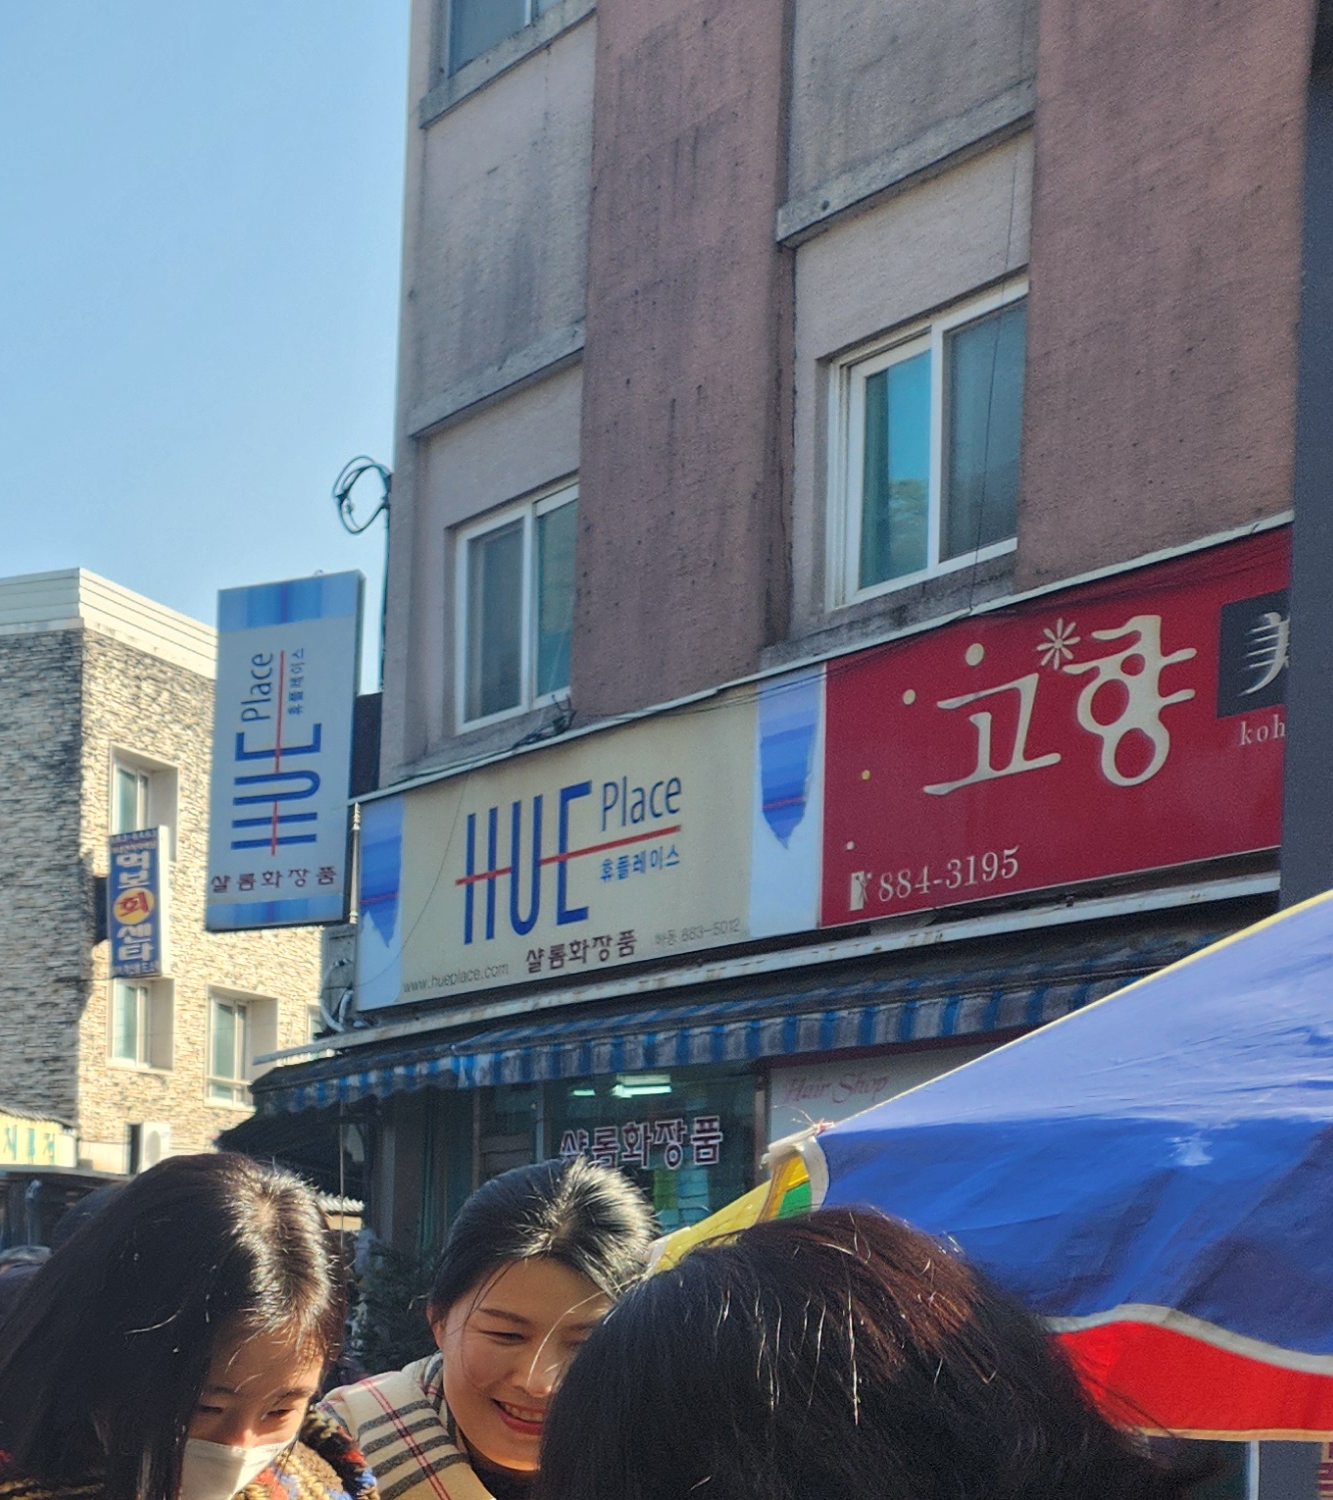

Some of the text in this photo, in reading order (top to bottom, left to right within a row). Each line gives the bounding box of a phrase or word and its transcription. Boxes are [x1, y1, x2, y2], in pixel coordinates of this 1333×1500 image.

[240, 652, 274, 724] Place
[923, 613, 1199, 797] 고향
[231, 722, 322, 851] HUE
[600, 776, 681, 832] Place
[210, 865, 338, 894] 샬롬화장품
[463, 780, 592, 945] HUE
[599, 847, 680, 882] 휴플레이스
[878, 845, 1020, 902] 884-3195
[402, 962, 510, 993] www.hueplace.com
[525, 929, 638, 974] 샬롬화장품
[787, 1072, 889, 1104] Hair Shop
